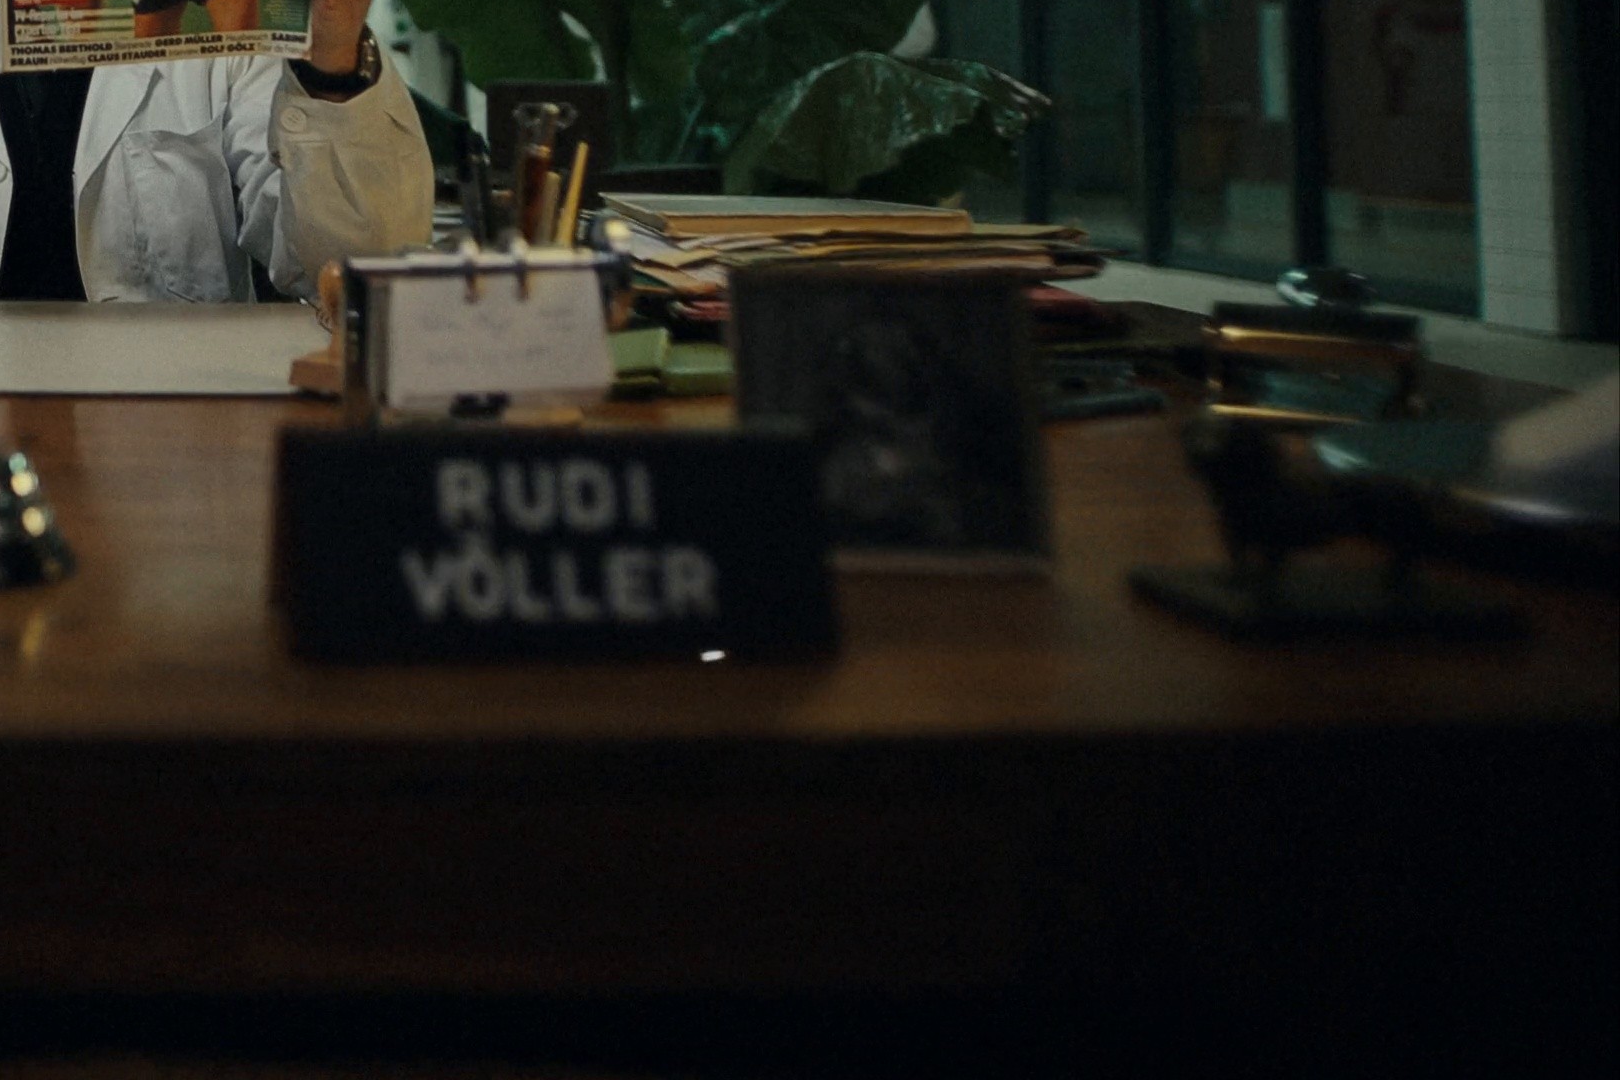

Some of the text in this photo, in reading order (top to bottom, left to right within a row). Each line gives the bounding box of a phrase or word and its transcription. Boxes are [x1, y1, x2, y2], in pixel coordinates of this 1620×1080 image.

[10, 44, 56, 55] THOMAS
[59, 42, 113, 53] BERTHOLD
[155, 37, 183, 47] GERD
[184, 33, 223, 44] MÜLLER
[10, 56, 48, 66] BRAUN
[88, 53, 120, 63] CLAUS
[436, 458, 656, 532] RUDI
[400, 531, 722, 623] VÖLLER
